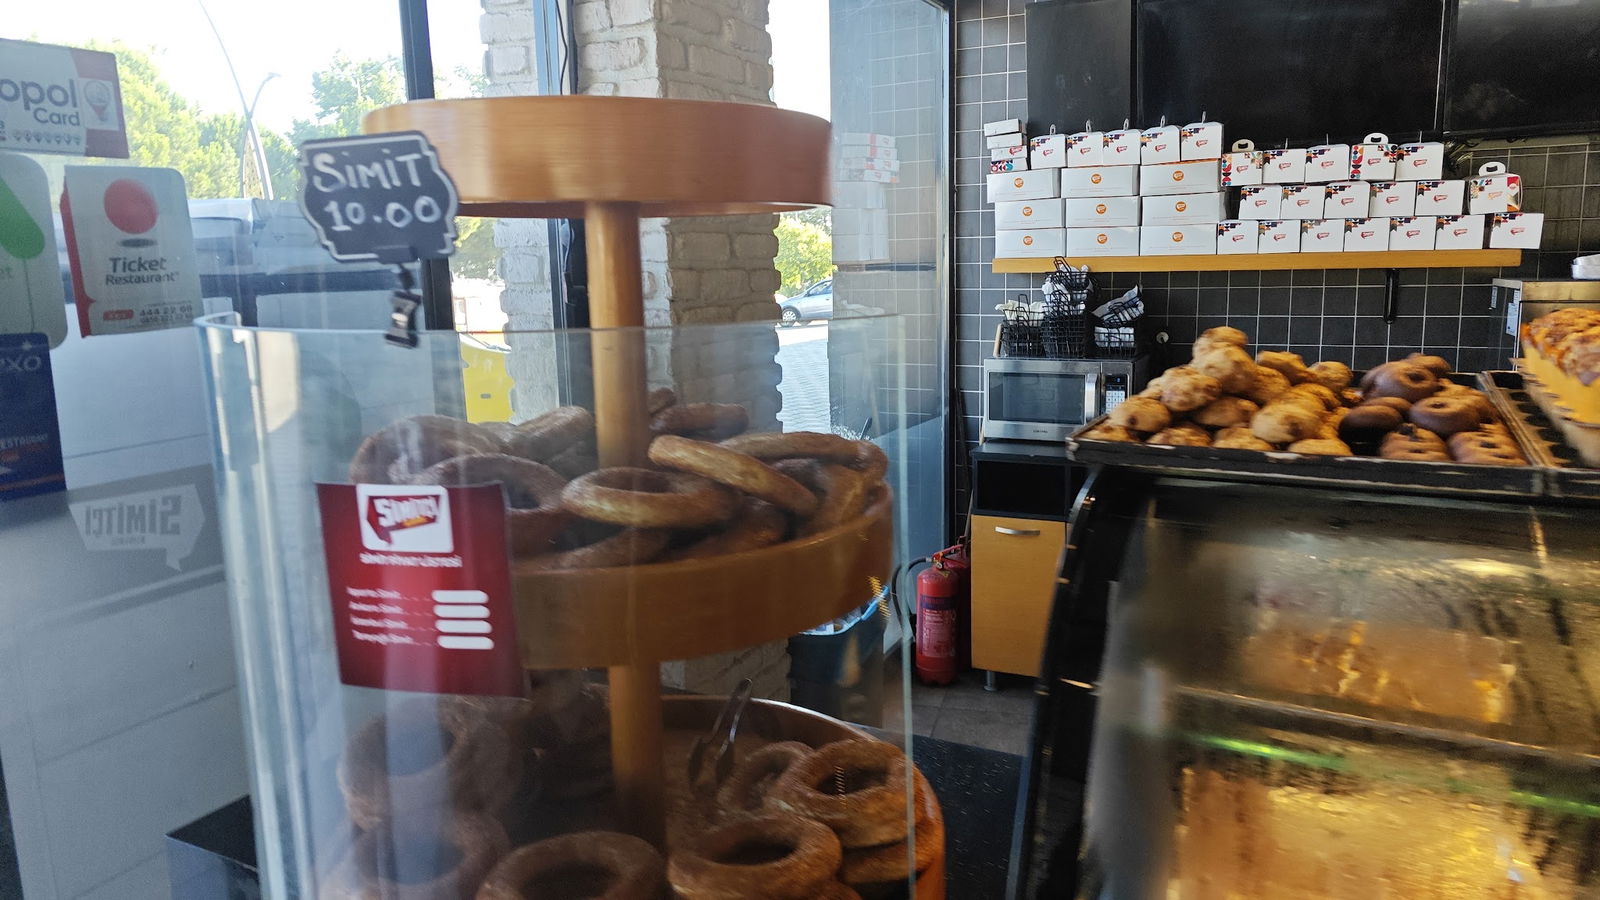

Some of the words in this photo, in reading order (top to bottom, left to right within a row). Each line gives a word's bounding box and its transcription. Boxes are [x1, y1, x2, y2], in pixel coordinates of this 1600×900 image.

[33, 107, 80, 126] Card
[324, 195, 441, 231] 10.00
[109, 257, 167, 273] Ticket
